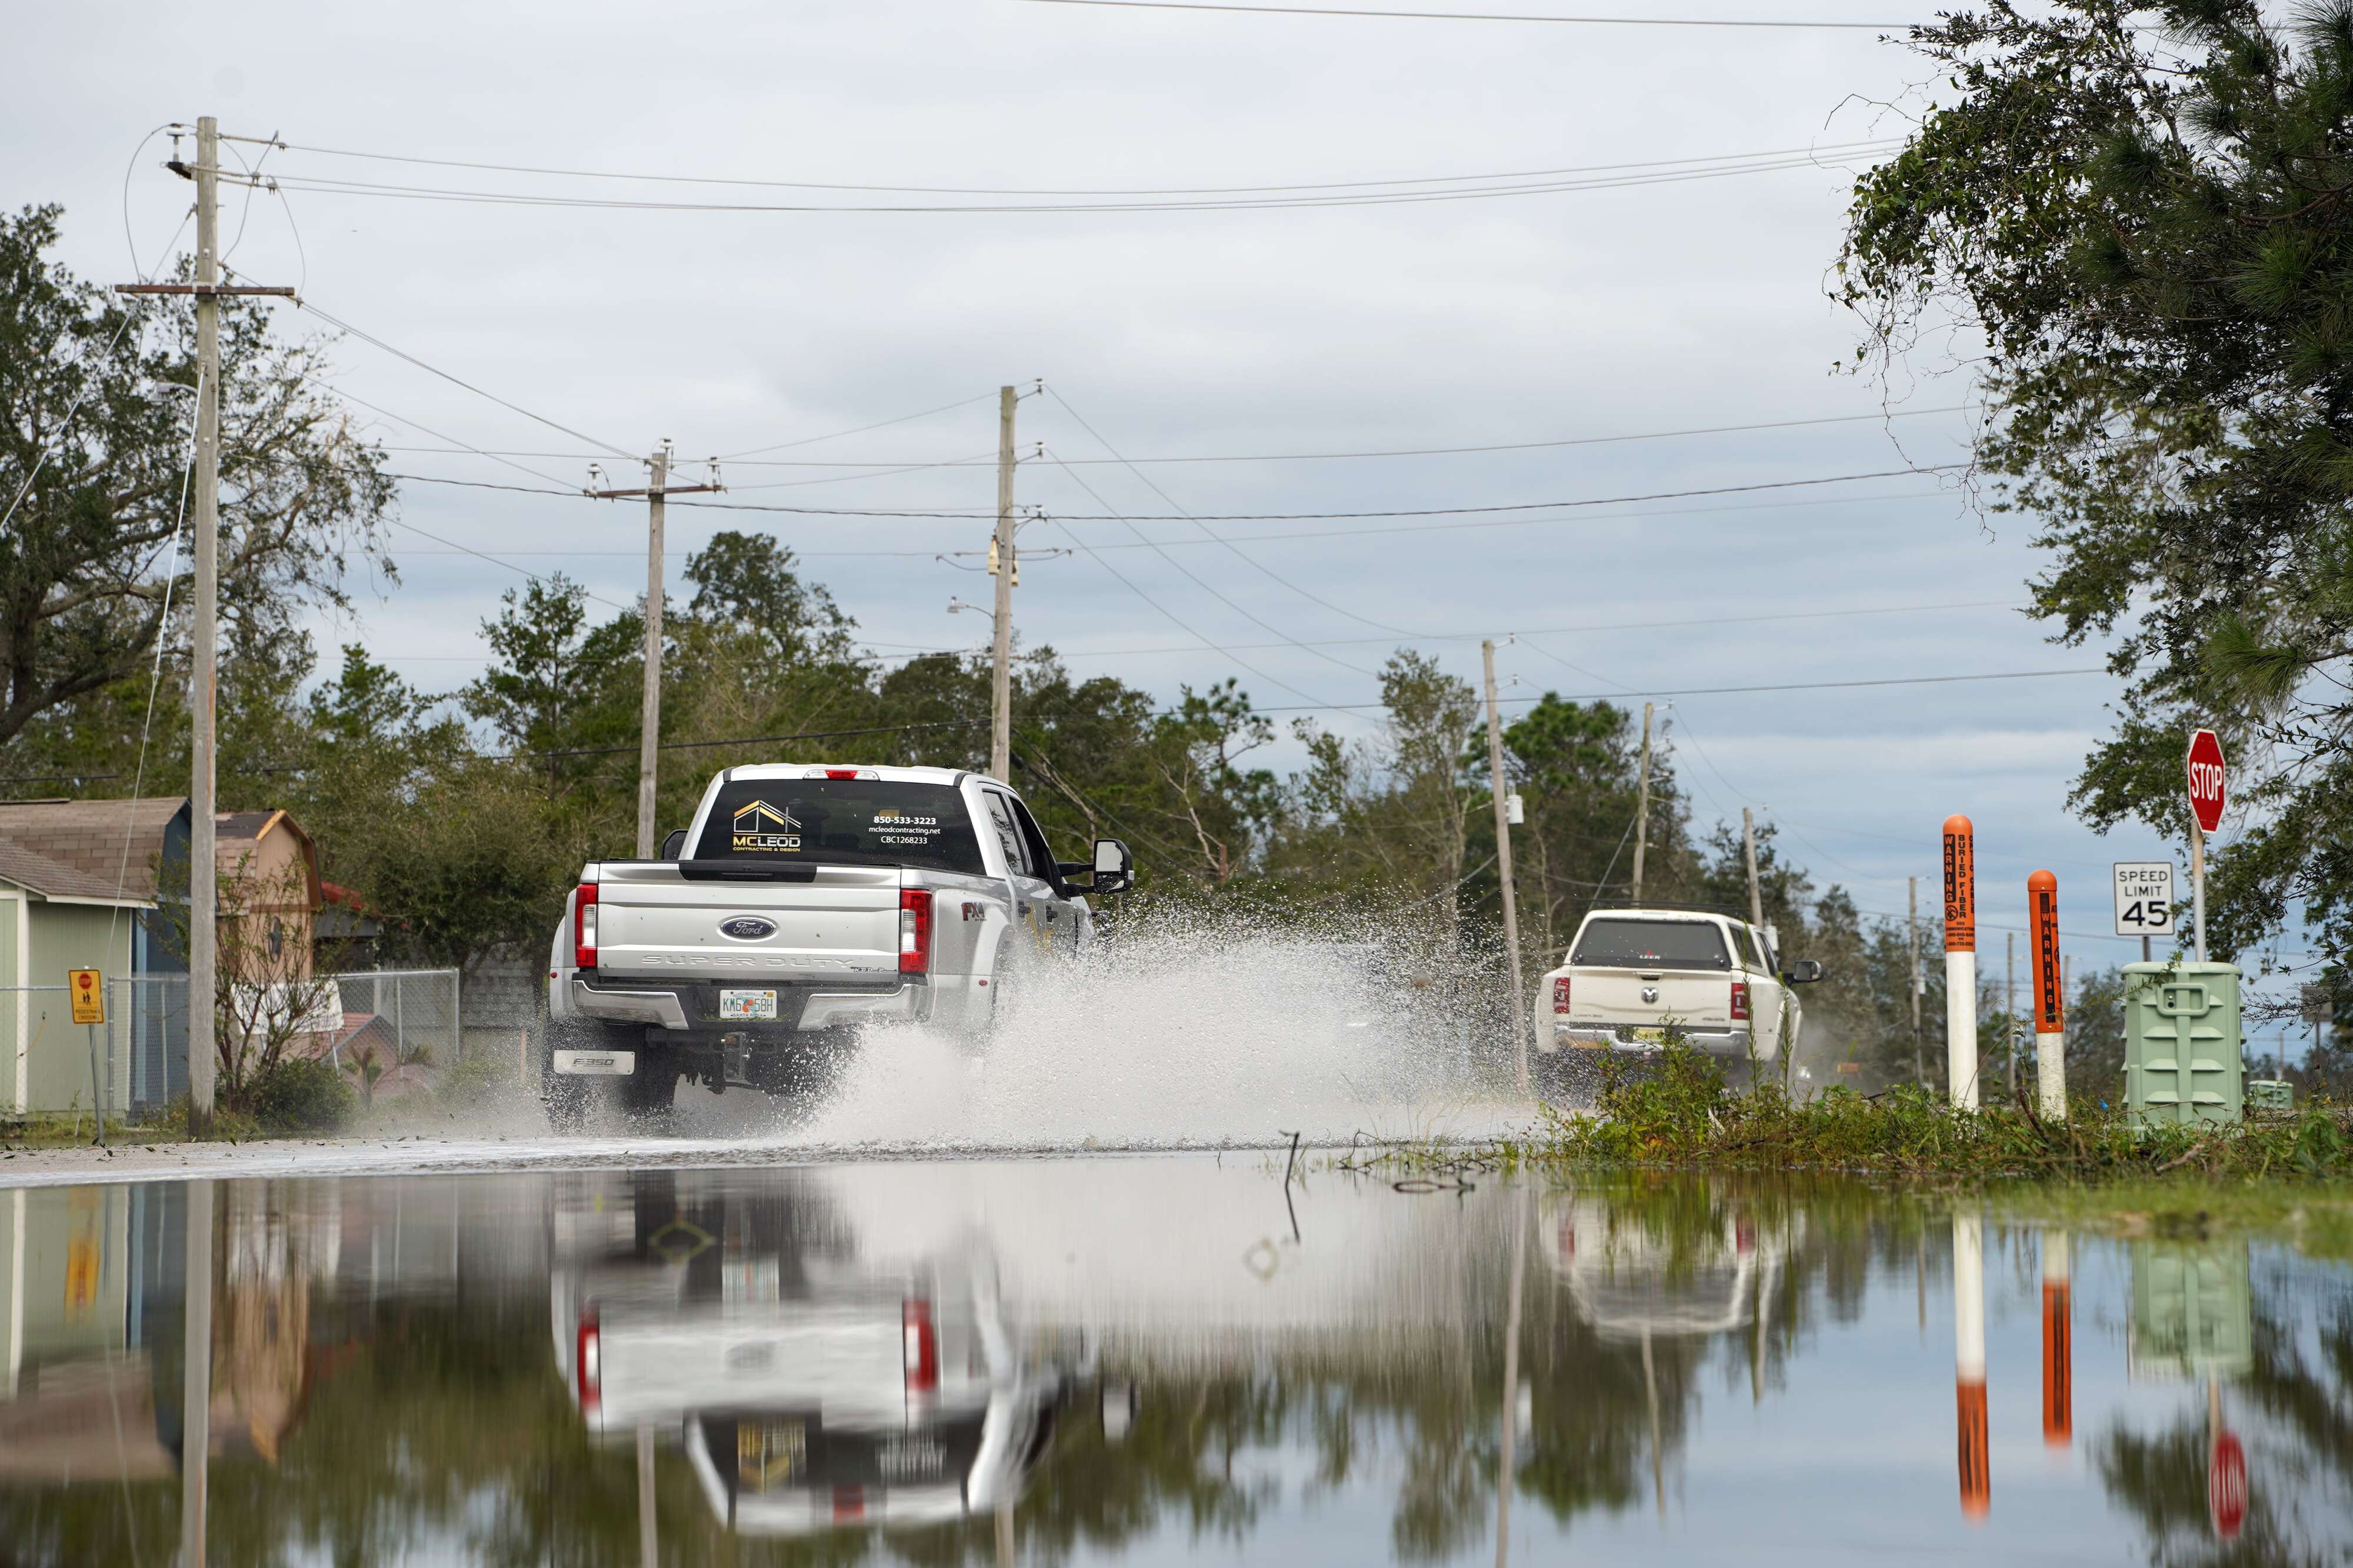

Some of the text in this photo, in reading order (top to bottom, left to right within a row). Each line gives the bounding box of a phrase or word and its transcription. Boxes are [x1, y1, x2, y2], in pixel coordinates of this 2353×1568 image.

[2191, 761, 2223, 801] STOP
[874, 816, 936, 825] 850-533-3223
[869, 826, 941, 835] mcleodcontracting.net
[733, 836, 801, 847] MCLEOD
[881, 836, 928, 844] CBC1268233
[1958, 835, 1967, 878] BURIED
[1944, 836, 1953, 901] WARNING
[2119, 871, 2168, 882] SPEED
[2125, 886, 2162, 896] LIMIT
[961, 902, 985, 921] FX4
[2122, 901, 2167, 926] 45
[733, 922, 763, 934] Ford
[642, 955, 854, 968] SUPER DUTY
[2041, 912, 2053, 1003] WARNING
[723, 998, 773, 1012] KM6 58H
